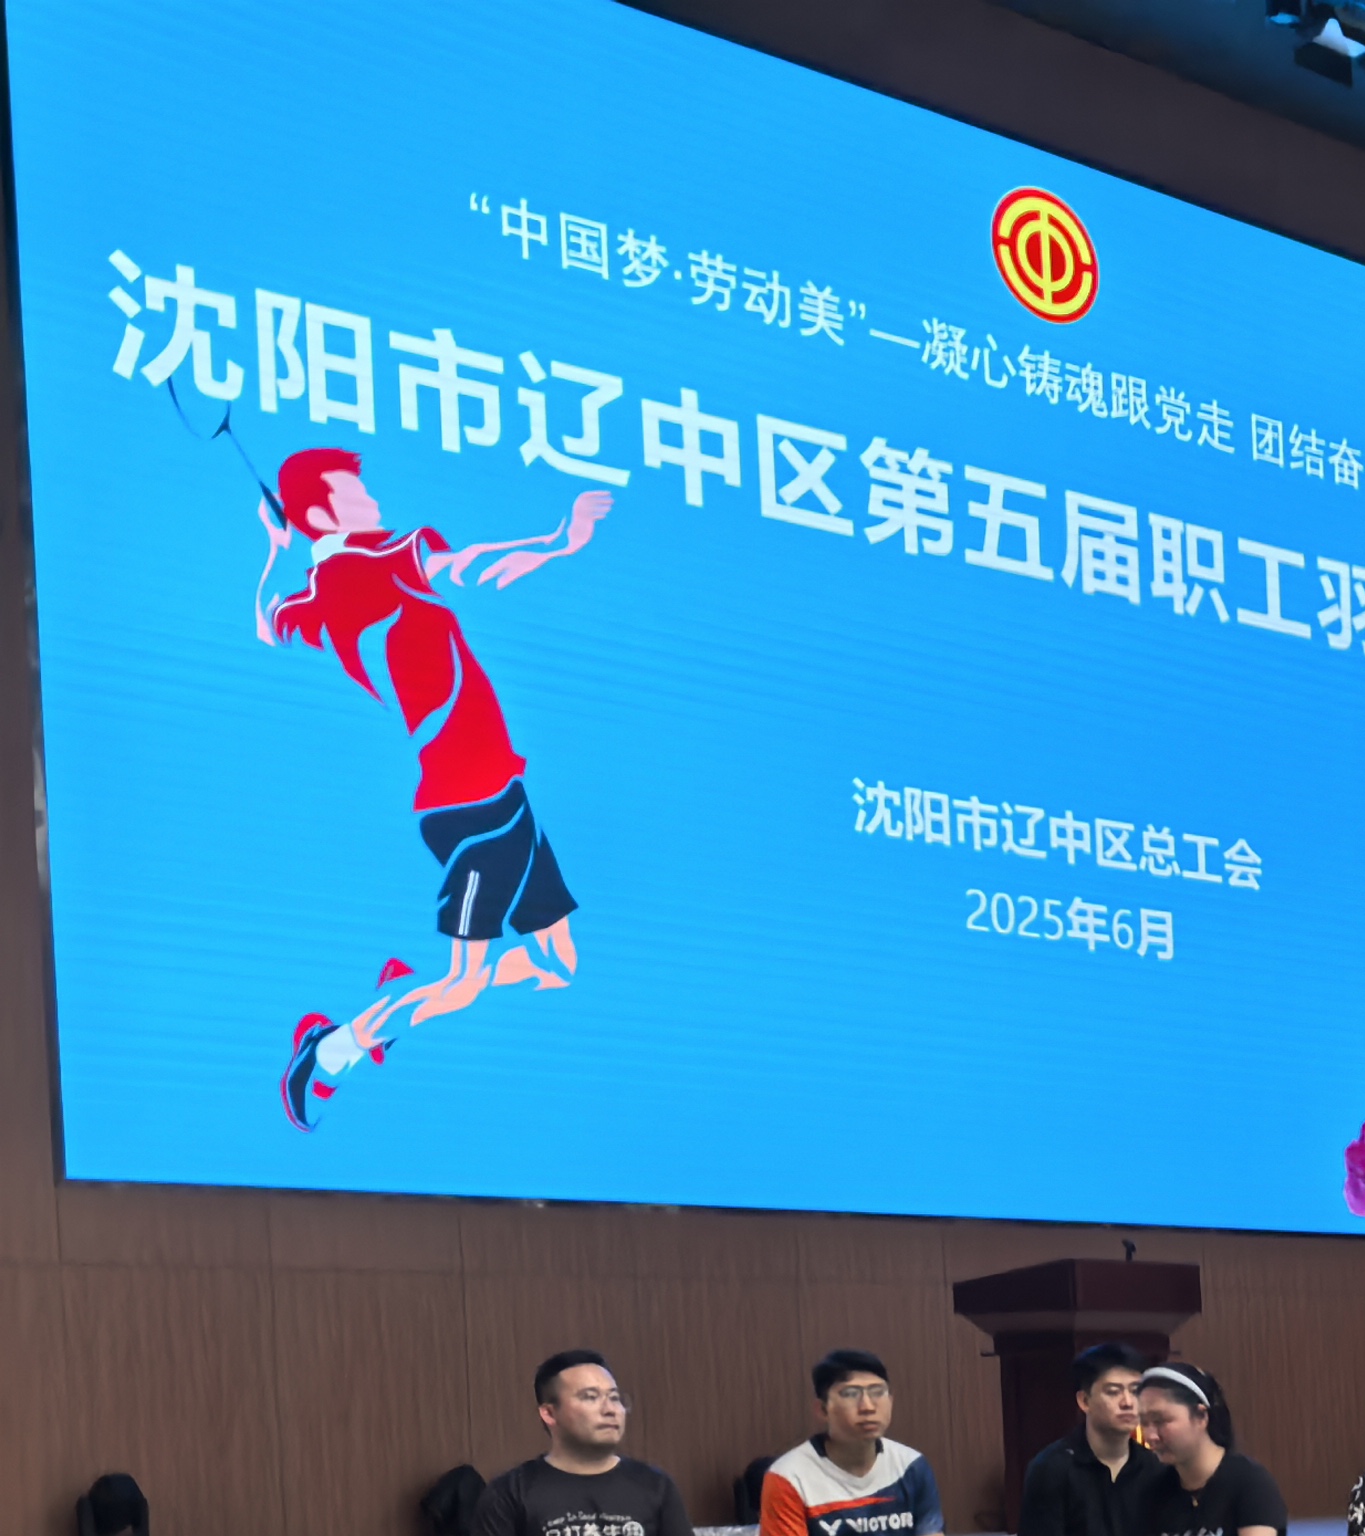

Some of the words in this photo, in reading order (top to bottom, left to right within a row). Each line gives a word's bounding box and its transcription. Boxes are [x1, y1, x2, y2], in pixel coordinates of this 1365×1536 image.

[852, 776, 1263, 891] 沈阳市辽中区总工会
[964, 888, 1175, 961] 2025年6月
[845, 1512, 914, 1533] VICTOR
